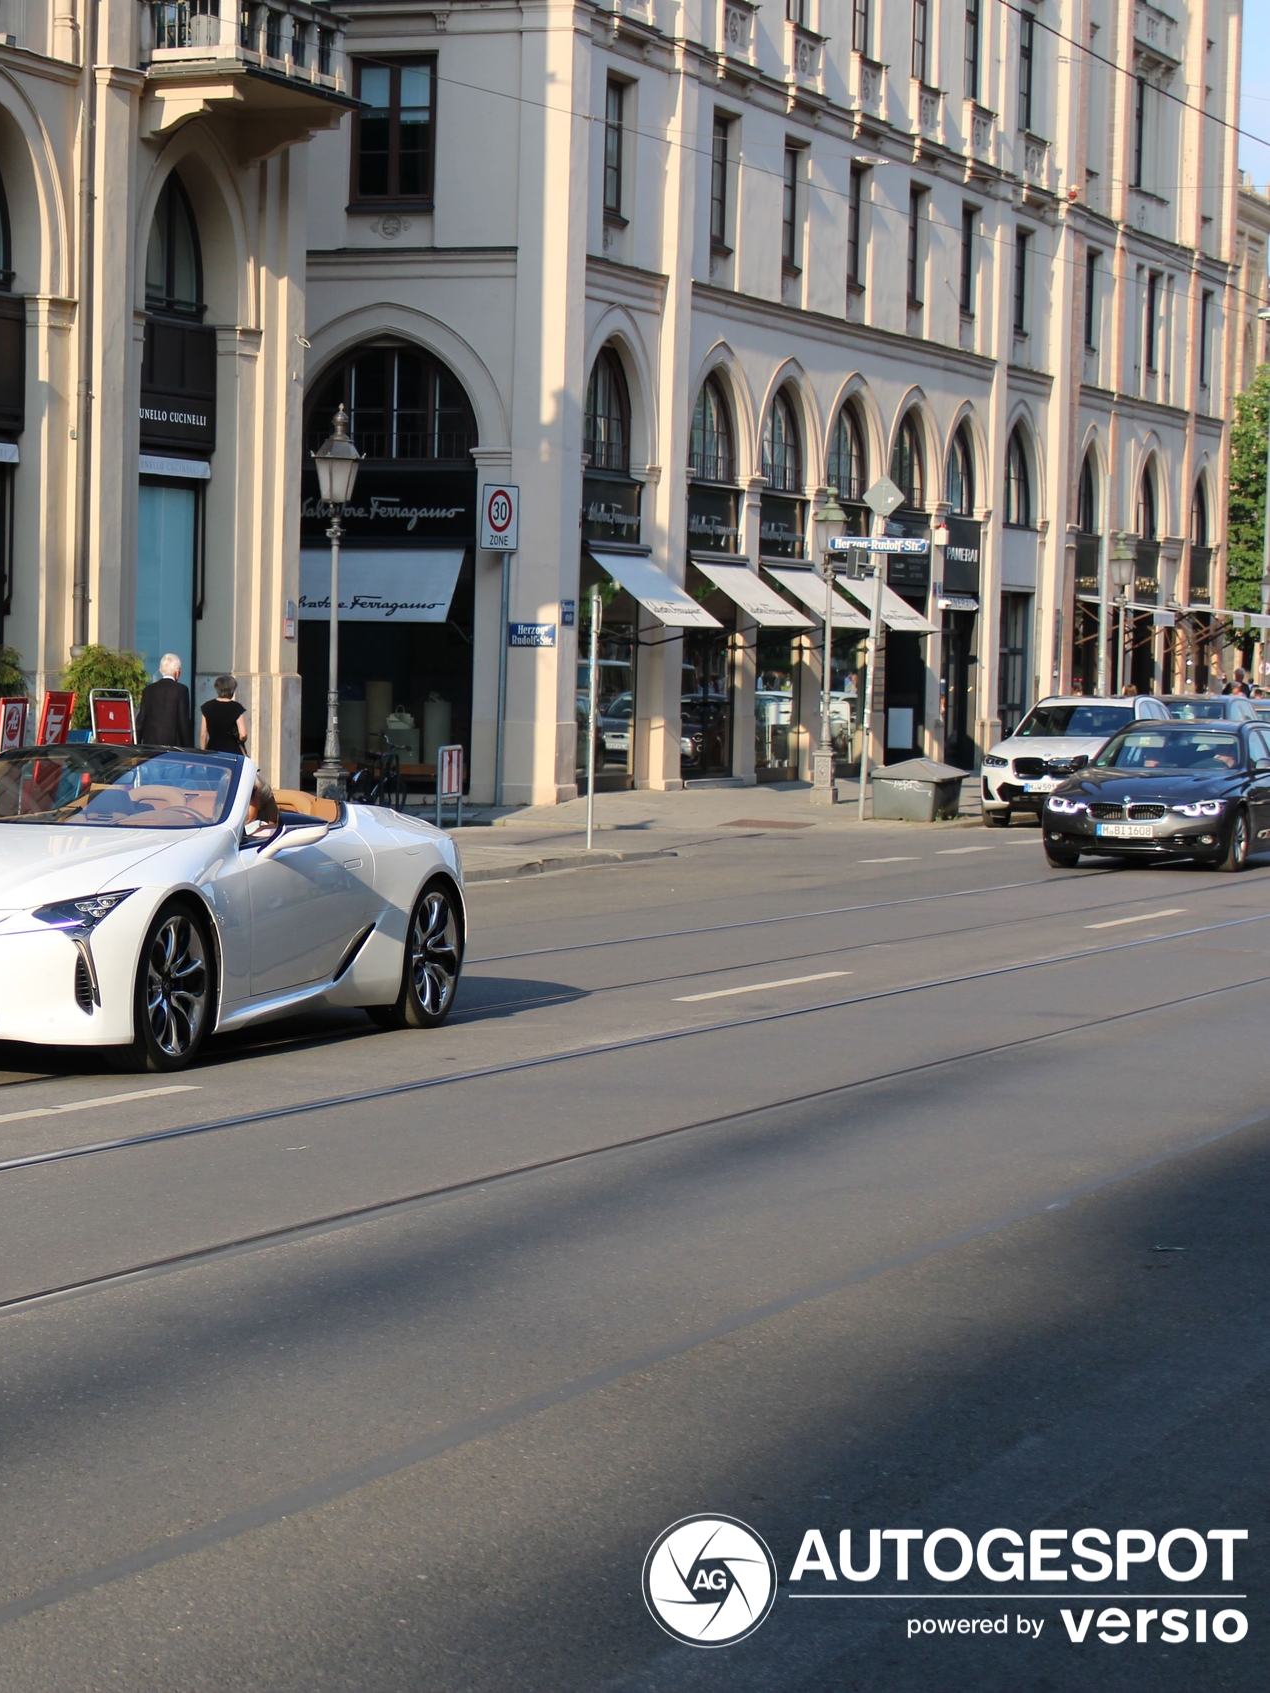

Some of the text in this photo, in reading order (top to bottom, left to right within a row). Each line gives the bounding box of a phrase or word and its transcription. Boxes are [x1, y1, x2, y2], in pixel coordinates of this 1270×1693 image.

[169, 411, 207, 427] CUCINELLI
[369, 496, 466, 531] Ferragamo
[492, 501, 508, 521] 30
[489, 535, 509, 546] ZONE
[946, 547, 978, 563] PANERAI
[350, 595, 446, 617] Ferragamo
[511, 635, 554, 646] Rudolf-Str.
[1126, 826, 1152, 836] 1608
